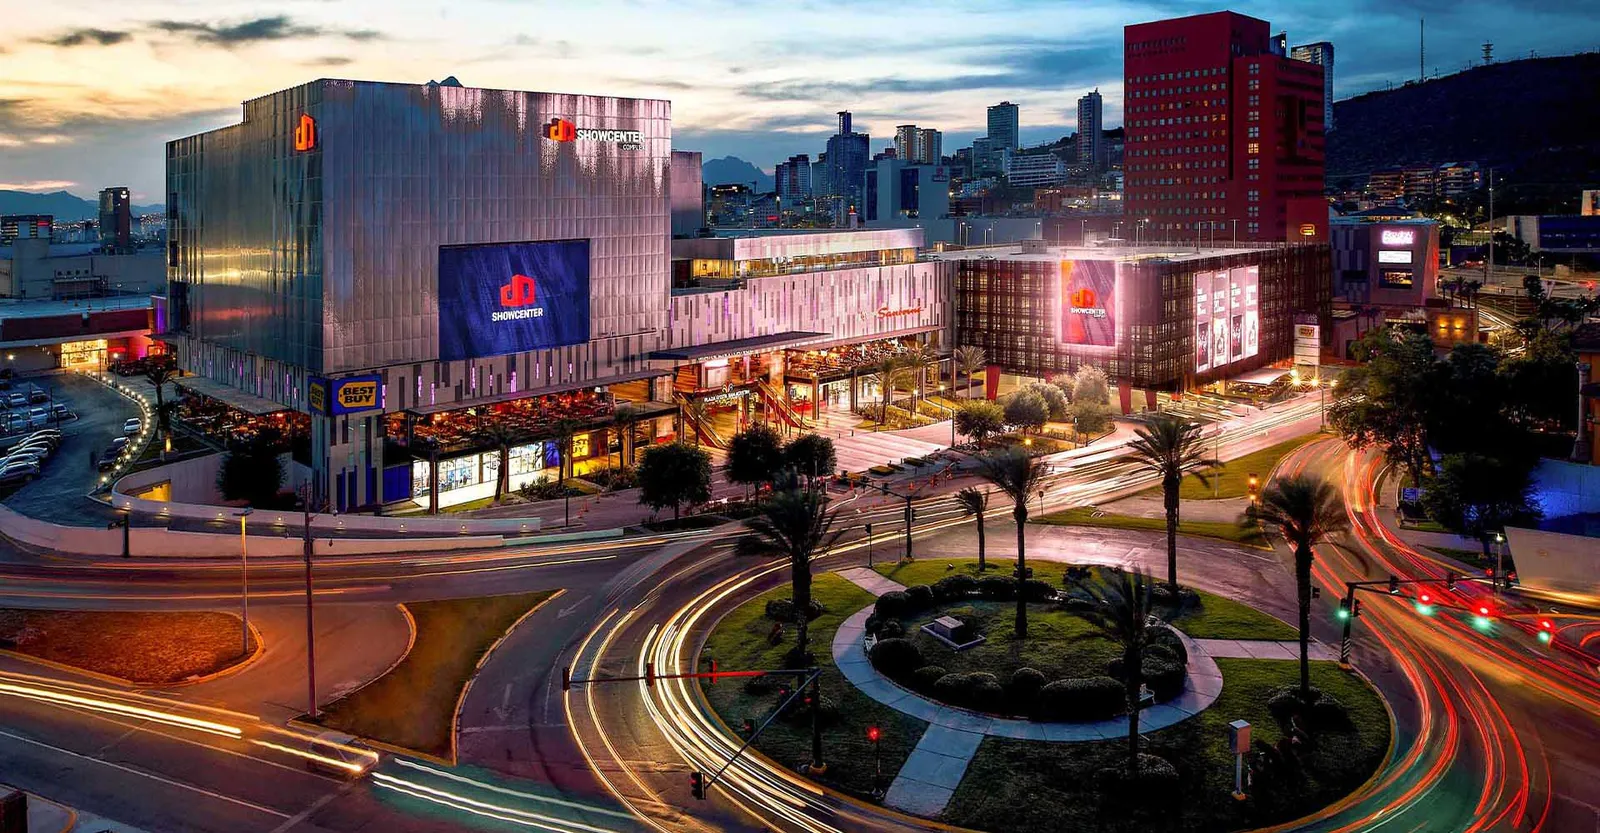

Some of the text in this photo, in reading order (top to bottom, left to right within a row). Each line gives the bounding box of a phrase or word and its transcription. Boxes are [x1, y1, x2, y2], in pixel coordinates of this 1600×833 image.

[577, 129, 645, 143] SHOWCENTER
[492, 307, 543, 321] SHOWCENTER
[343, 386, 375, 395] BEST
[344, 395, 372, 403] BUY
